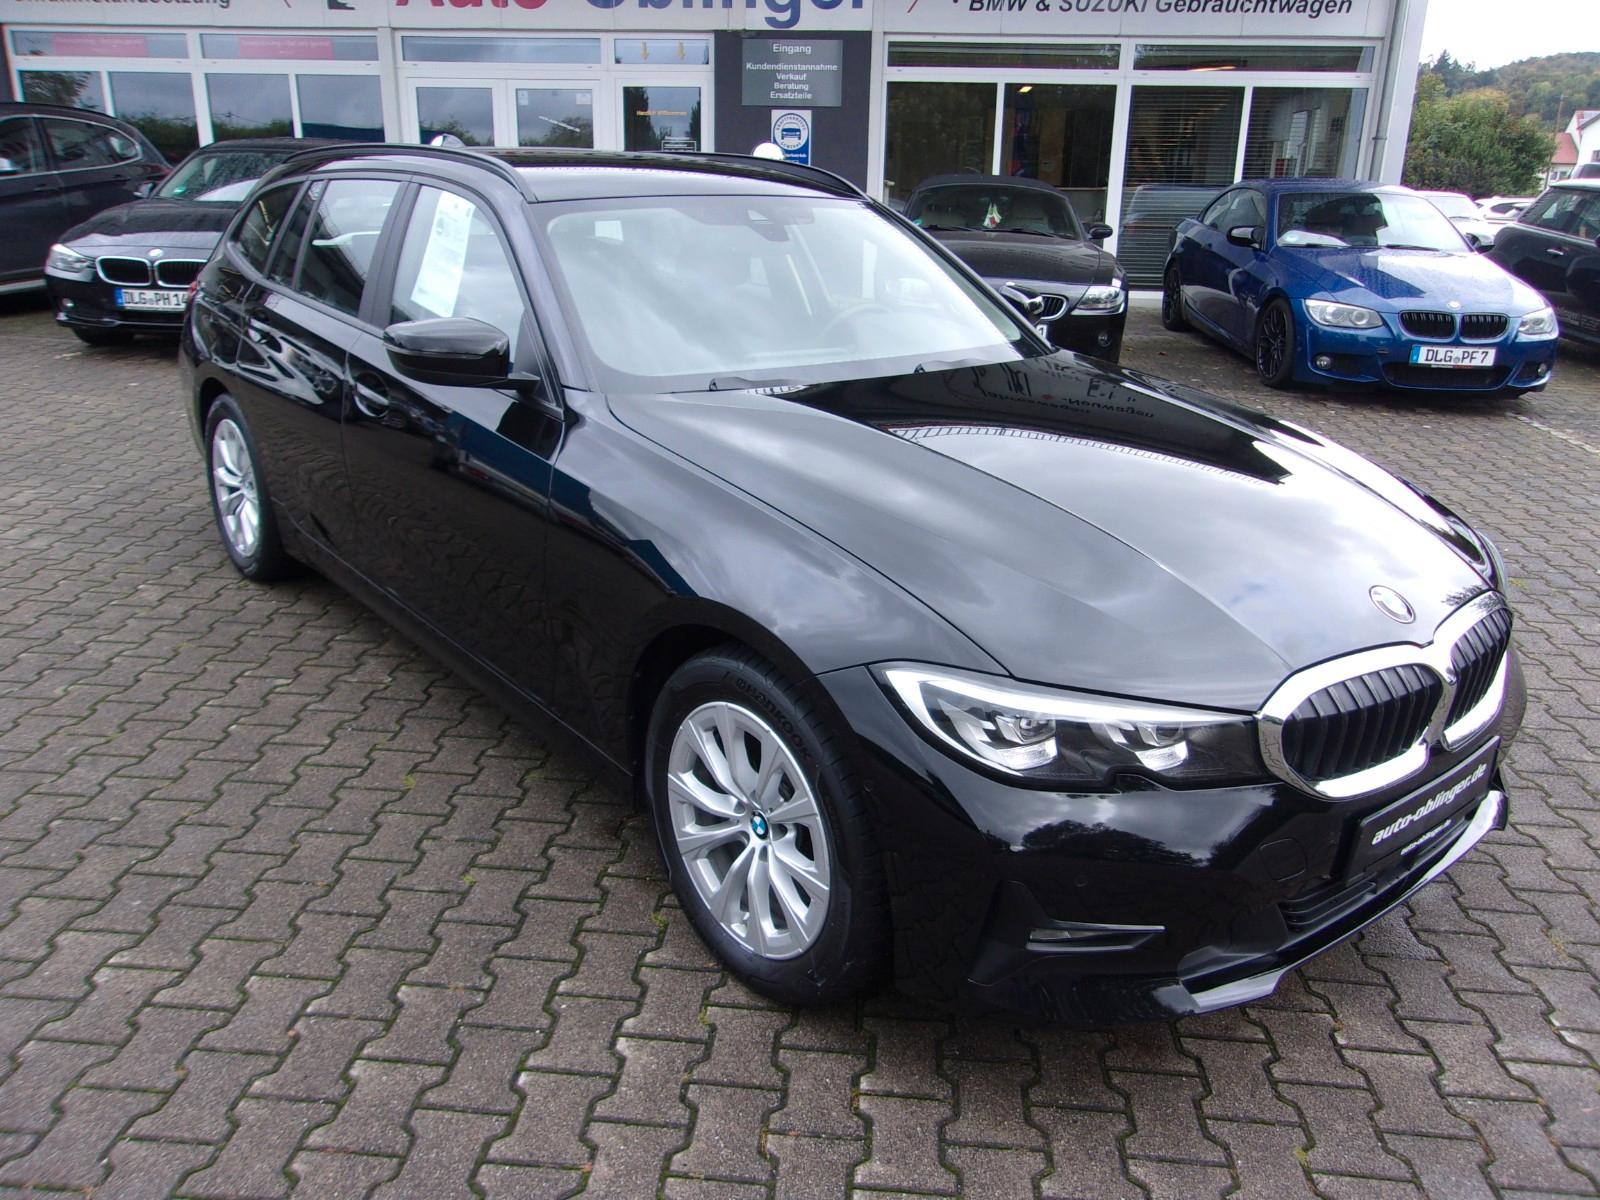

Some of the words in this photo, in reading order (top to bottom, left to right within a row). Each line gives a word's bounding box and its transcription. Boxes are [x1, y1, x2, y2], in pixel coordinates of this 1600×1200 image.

[968, 0, 1026, 11] BMW
[1155, 0, 1352, 18] Gebrauchtwagen
[772, 43, 812, 55] Eingang
[746, 62, 838, 71] Kundendienstannahme
[776, 72, 807, 81] Verkauf
[774, 82, 809, 91] Beratung
[770, 91, 812, 100] Ersatzteile
[1425, 349, 1453, 362] DLG
[1461, 350, 1480, 363] PF
[1481, 351, 1489, 363] 7
[1371, 763, 1487, 845] auto-oblinger.de
